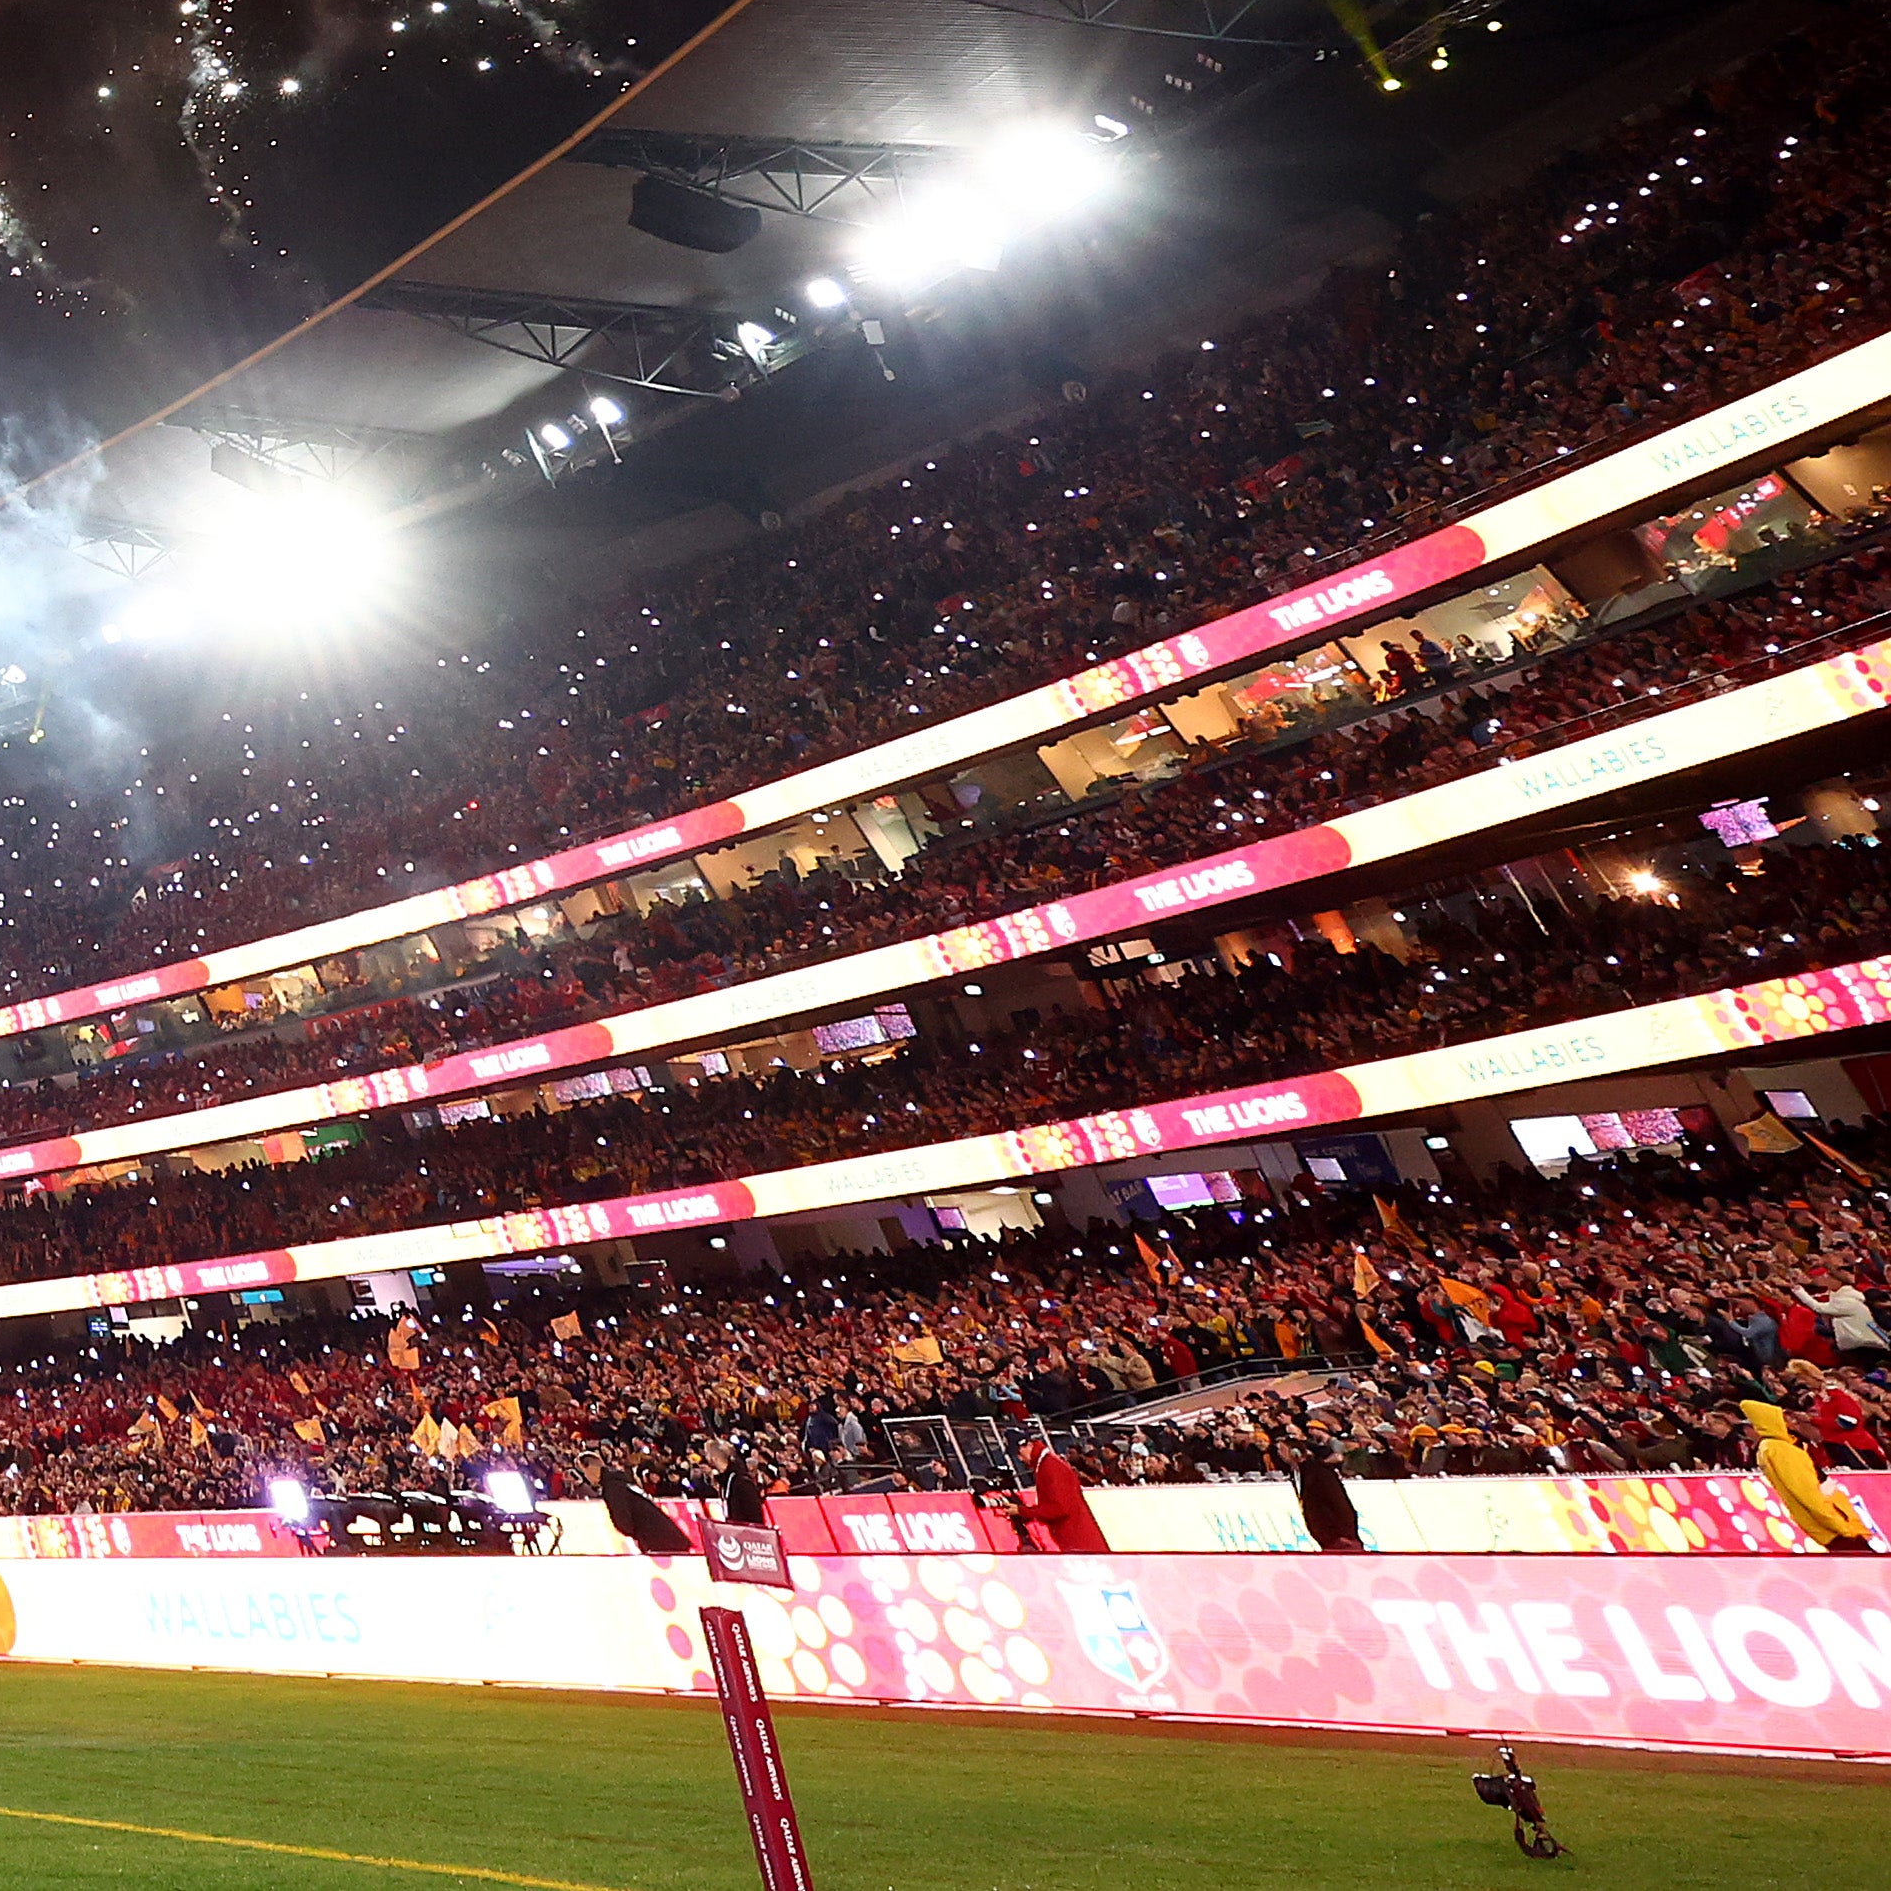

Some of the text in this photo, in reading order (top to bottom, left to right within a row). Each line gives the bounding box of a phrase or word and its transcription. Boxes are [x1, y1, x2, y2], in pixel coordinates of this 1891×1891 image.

[1652, 395, 1810, 473] WALLABIES
[1268, 570, 1393, 631] THE LIONS
[1514, 736, 1666, 800] WALLABIES
[628, 827, 681, 857] LIONS
[1134, 860, 1255, 911] THE LIONS
[499, 1043, 550, 1071] LIONS
[1460, 1036, 1605, 1082] WALLABIES
[1181, 1092, 1307, 1135] THE LIONS
[626, 1194, 719, 1226] THE LIONS
[208, 1524, 262, 1551] LIONS
[842, 1512, 976, 1551] THE LIONS
[1203, 1511, 1378, 1551] WALLAS
[143, 1591, 362, 1644] WALLABIES
[1372, 1600, 1611, 1697] THE
[756, 1718, 783, 1800] QATAR AIRWAYS
[780, 1817, 796, 1855] QATAR
